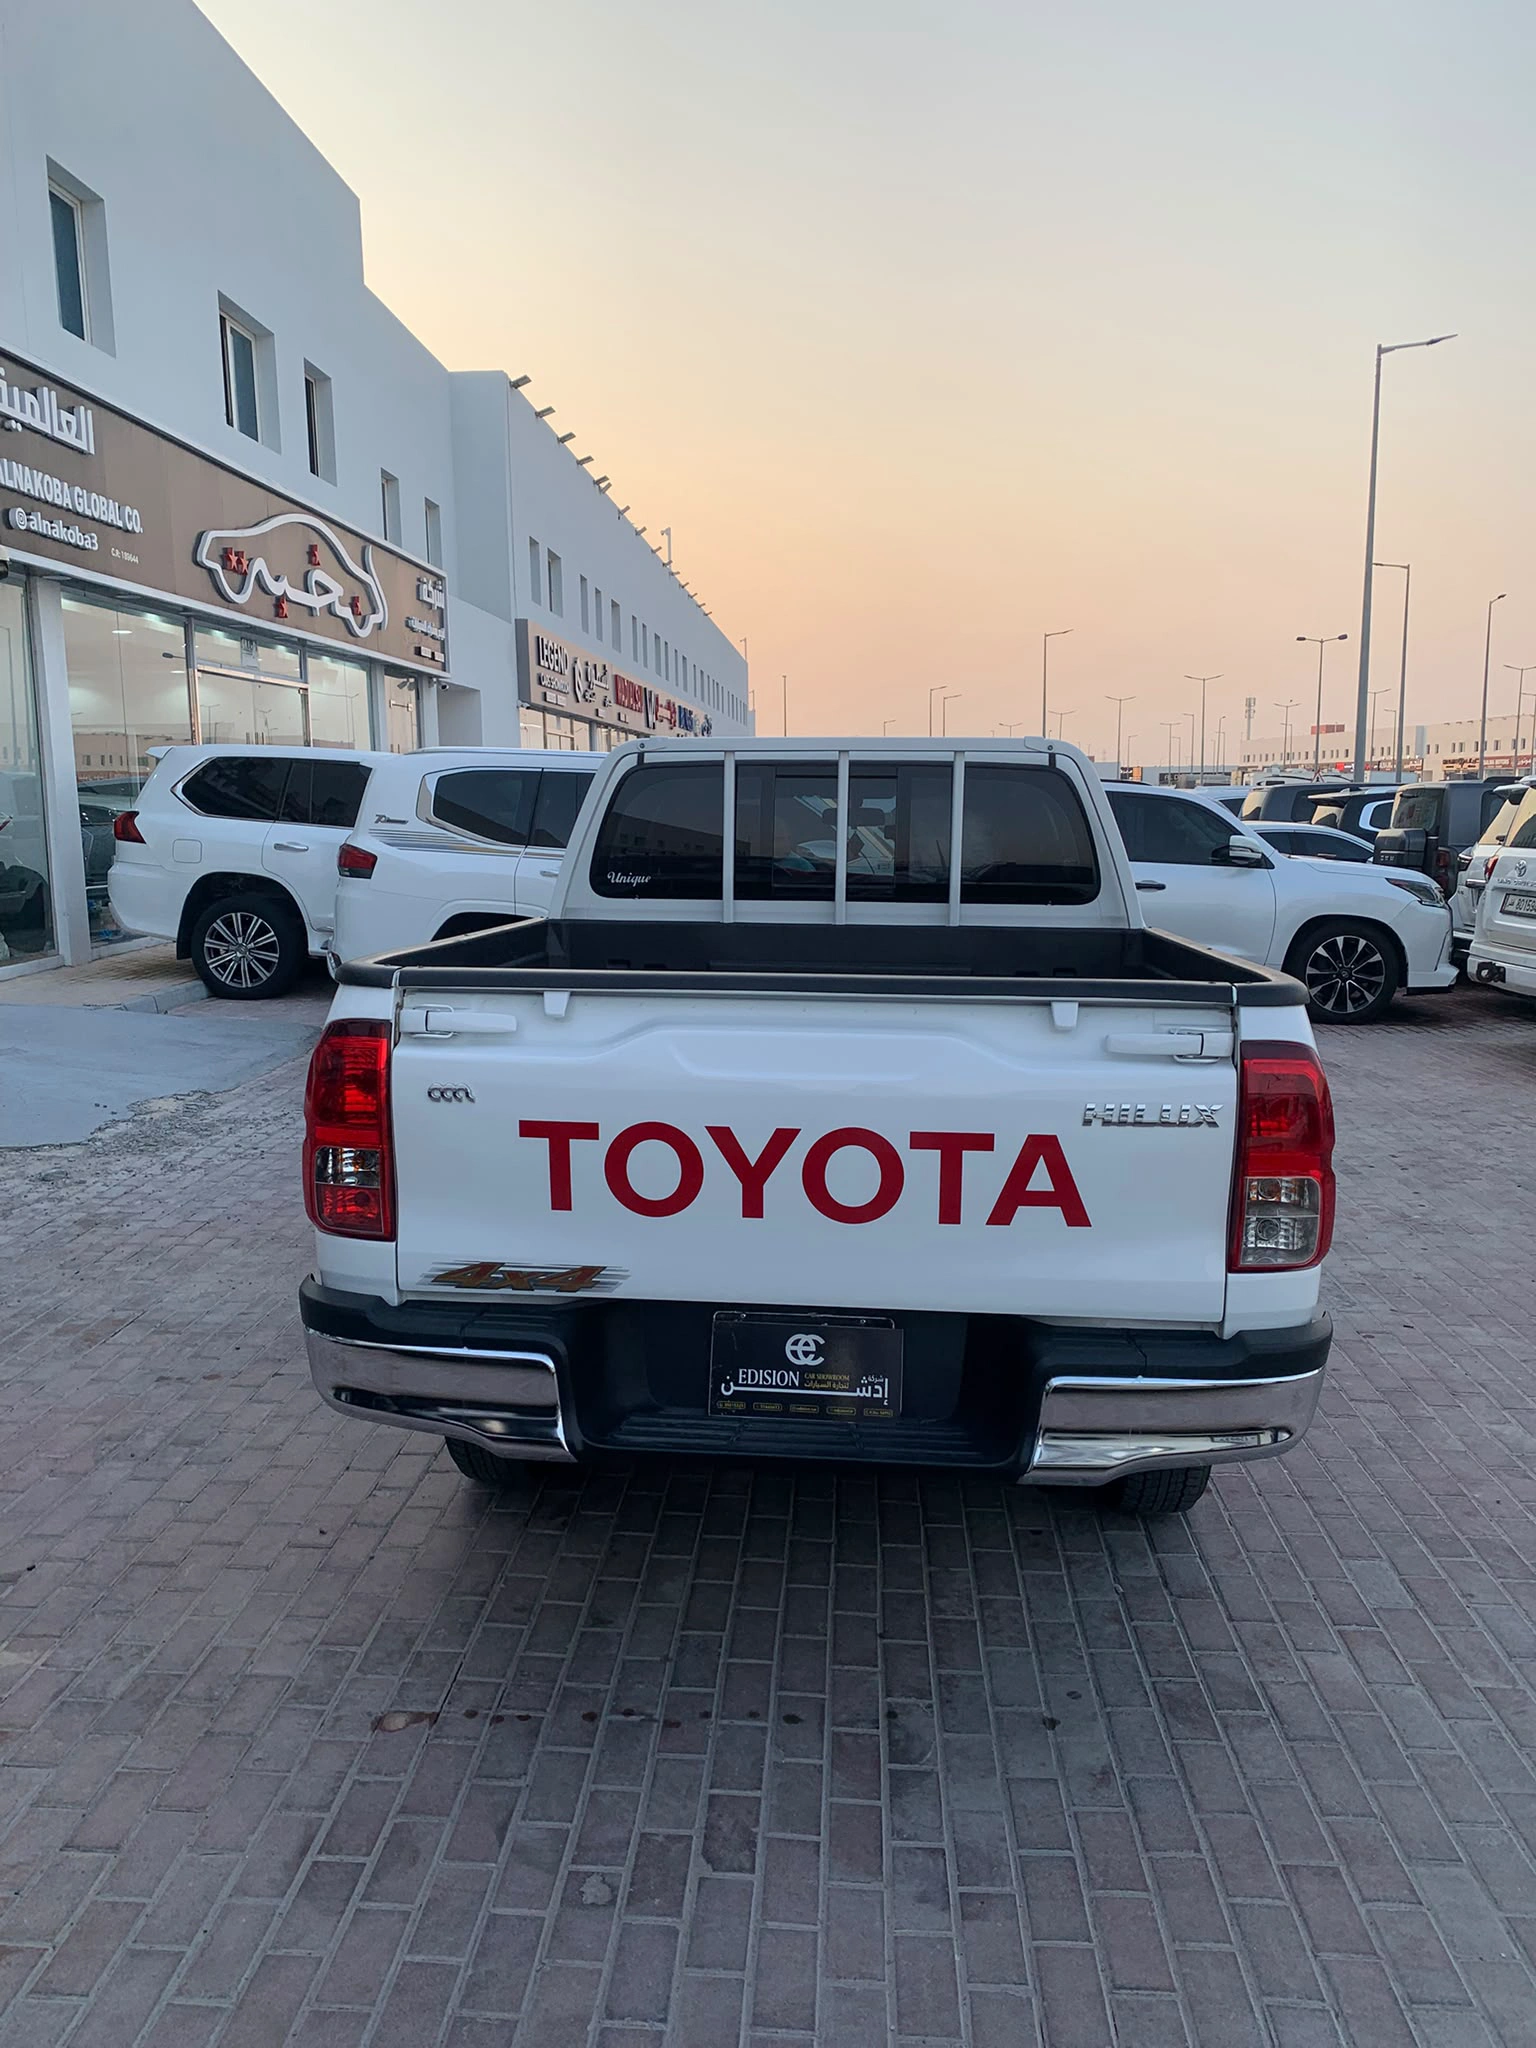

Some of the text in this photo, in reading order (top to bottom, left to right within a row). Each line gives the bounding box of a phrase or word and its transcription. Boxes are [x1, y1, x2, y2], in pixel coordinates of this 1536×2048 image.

[74, 486, 123, 528] GLOBAL
[125, 505, 143, 534] CO.
[538, 635, 569, 675] LEGEND
[607, 871, 651, 887] Unique
[1082, 1103, 1223, 1128] HILUX
[519, 1120, 1092, 1227] TOYOTA
[738, 1368, 800, 1387] EDISION
